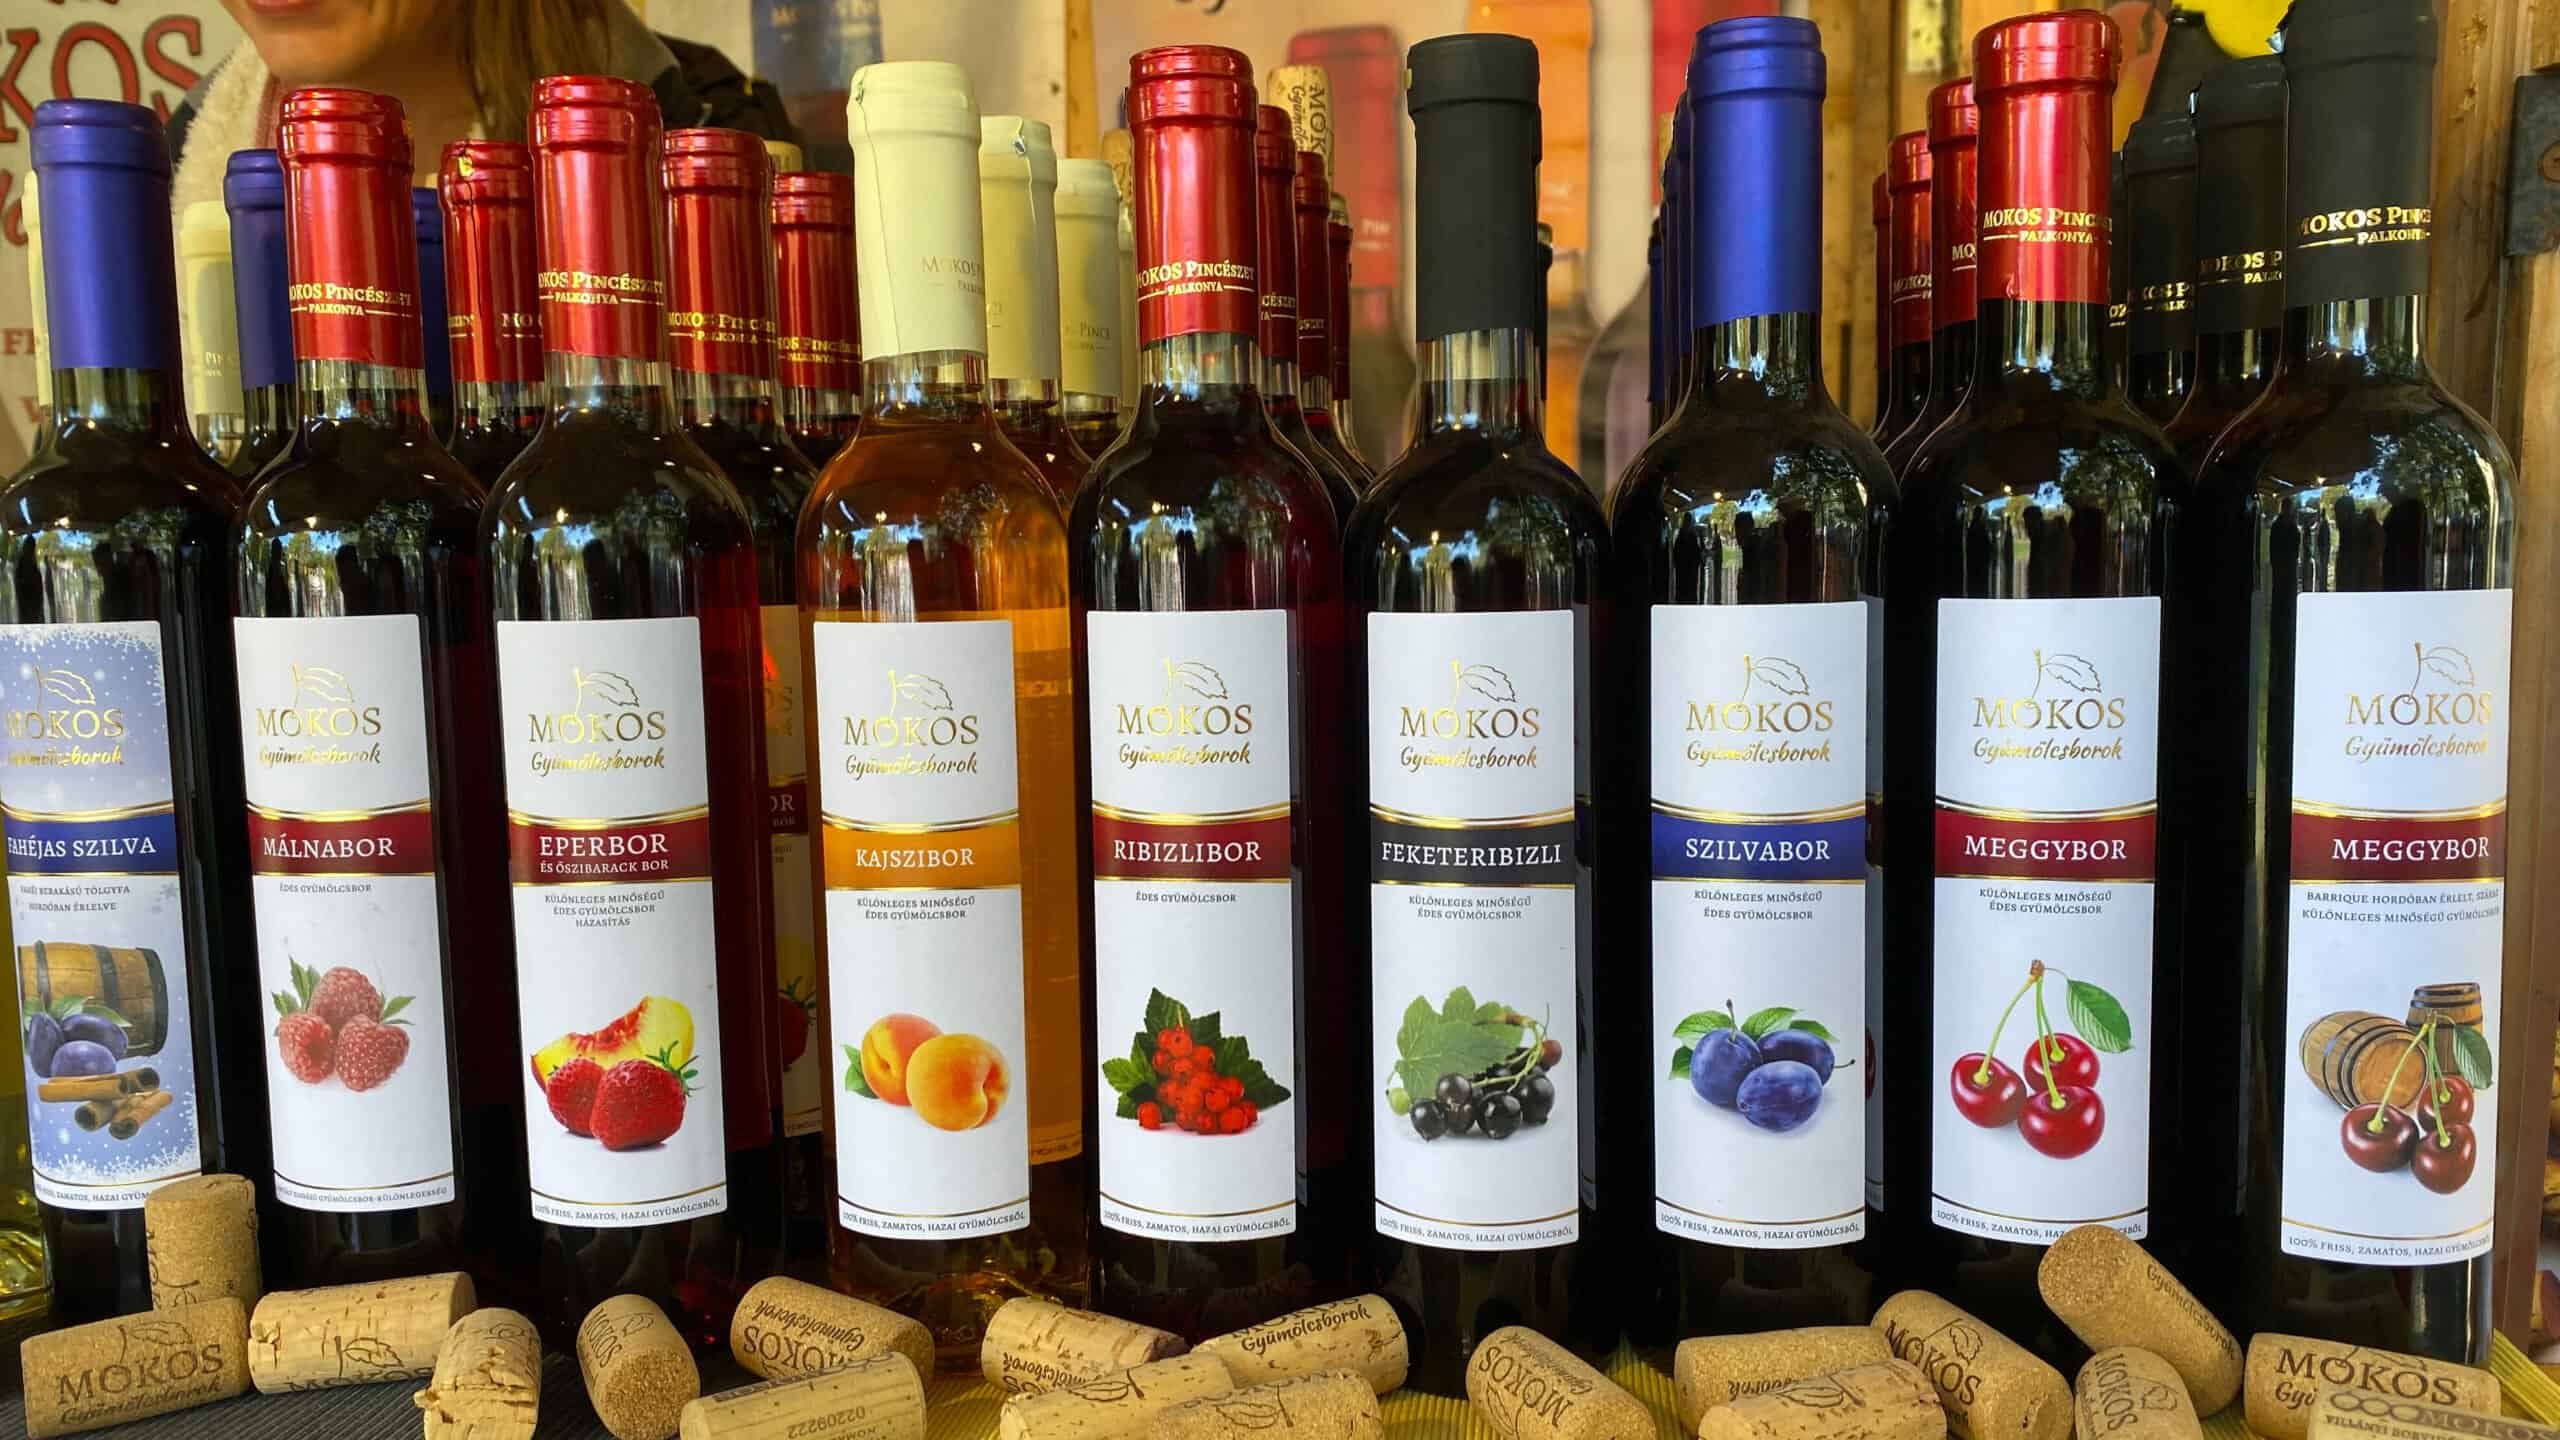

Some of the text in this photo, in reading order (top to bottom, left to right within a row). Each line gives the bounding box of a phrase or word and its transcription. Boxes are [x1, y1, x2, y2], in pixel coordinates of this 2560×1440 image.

[1984, 207, 2042, 228] MOKOS
[1117, 704, 1253, 736] MOKOS
[1686, 700, 1833, 733] MOKOS
[1973, 697, 2127, 730] MOKOS
[2345, 691, 2493, 726] MOKOS
[256, 707, 382, 737] MOKOS
[528, 711, 666, 744] MOKOS
[844, 714, 979, 747] MOKOS
[1400, 706, 1540, 740] MOKOS
[72, 836, 157, 858] SZILVA
[264, 832, 396, 858] MÁLNABOR
[540, 833, 669, 857] EPERBOR
[1113, 839, 1262, 864] RIBIZLIBOR
[1381, 842, 1561, 867] FEKETERIBIZLI
[1685, 838, 1830, 862] SZILVABOR
[1964, 835, 2127, 861] MEGGYBOR
[2332, 837, 2489, 861] MEGGYBOR
[540, 859, 669, 874] ÉS ŐSZIBARACK BOR
[856, 847, 975, 870] KAJSZIBOR
[1979, 887, 2112, 902] KÜLÖNLEGES MINŐSÉGŰ
[2307, 890, 2369, 905] BARRIQUE
[2371, 894, 2438, 905] HORDÓBAN
[1989, 901, 2103, 915] ÉDES GYÜMÖLCSBOR
[2302, 908, 2382, 922] KÜLÖNLEGES
[2384, 911, 2445, 923] MINŐSÉGŰ
[1711, 1226, 1761, 1240] ZAMATOS,
[1764, 1231, 1794, 1239] HAZAI
[1991, 1224, 2042, 1239] ZAMATOS,
[1241, 1304, 1372, 1355] Gyümölcsborok
[56, 1344, 224, 1404] MOKOS
[1884, 1319, 1981, 1406] MOKOS
[1478, 1346, 1574, 1429] MOKOS
[2275, 1348, 2458, 1406] MOKOS
[2095, 1353, 2138, 1431] MOKOS
